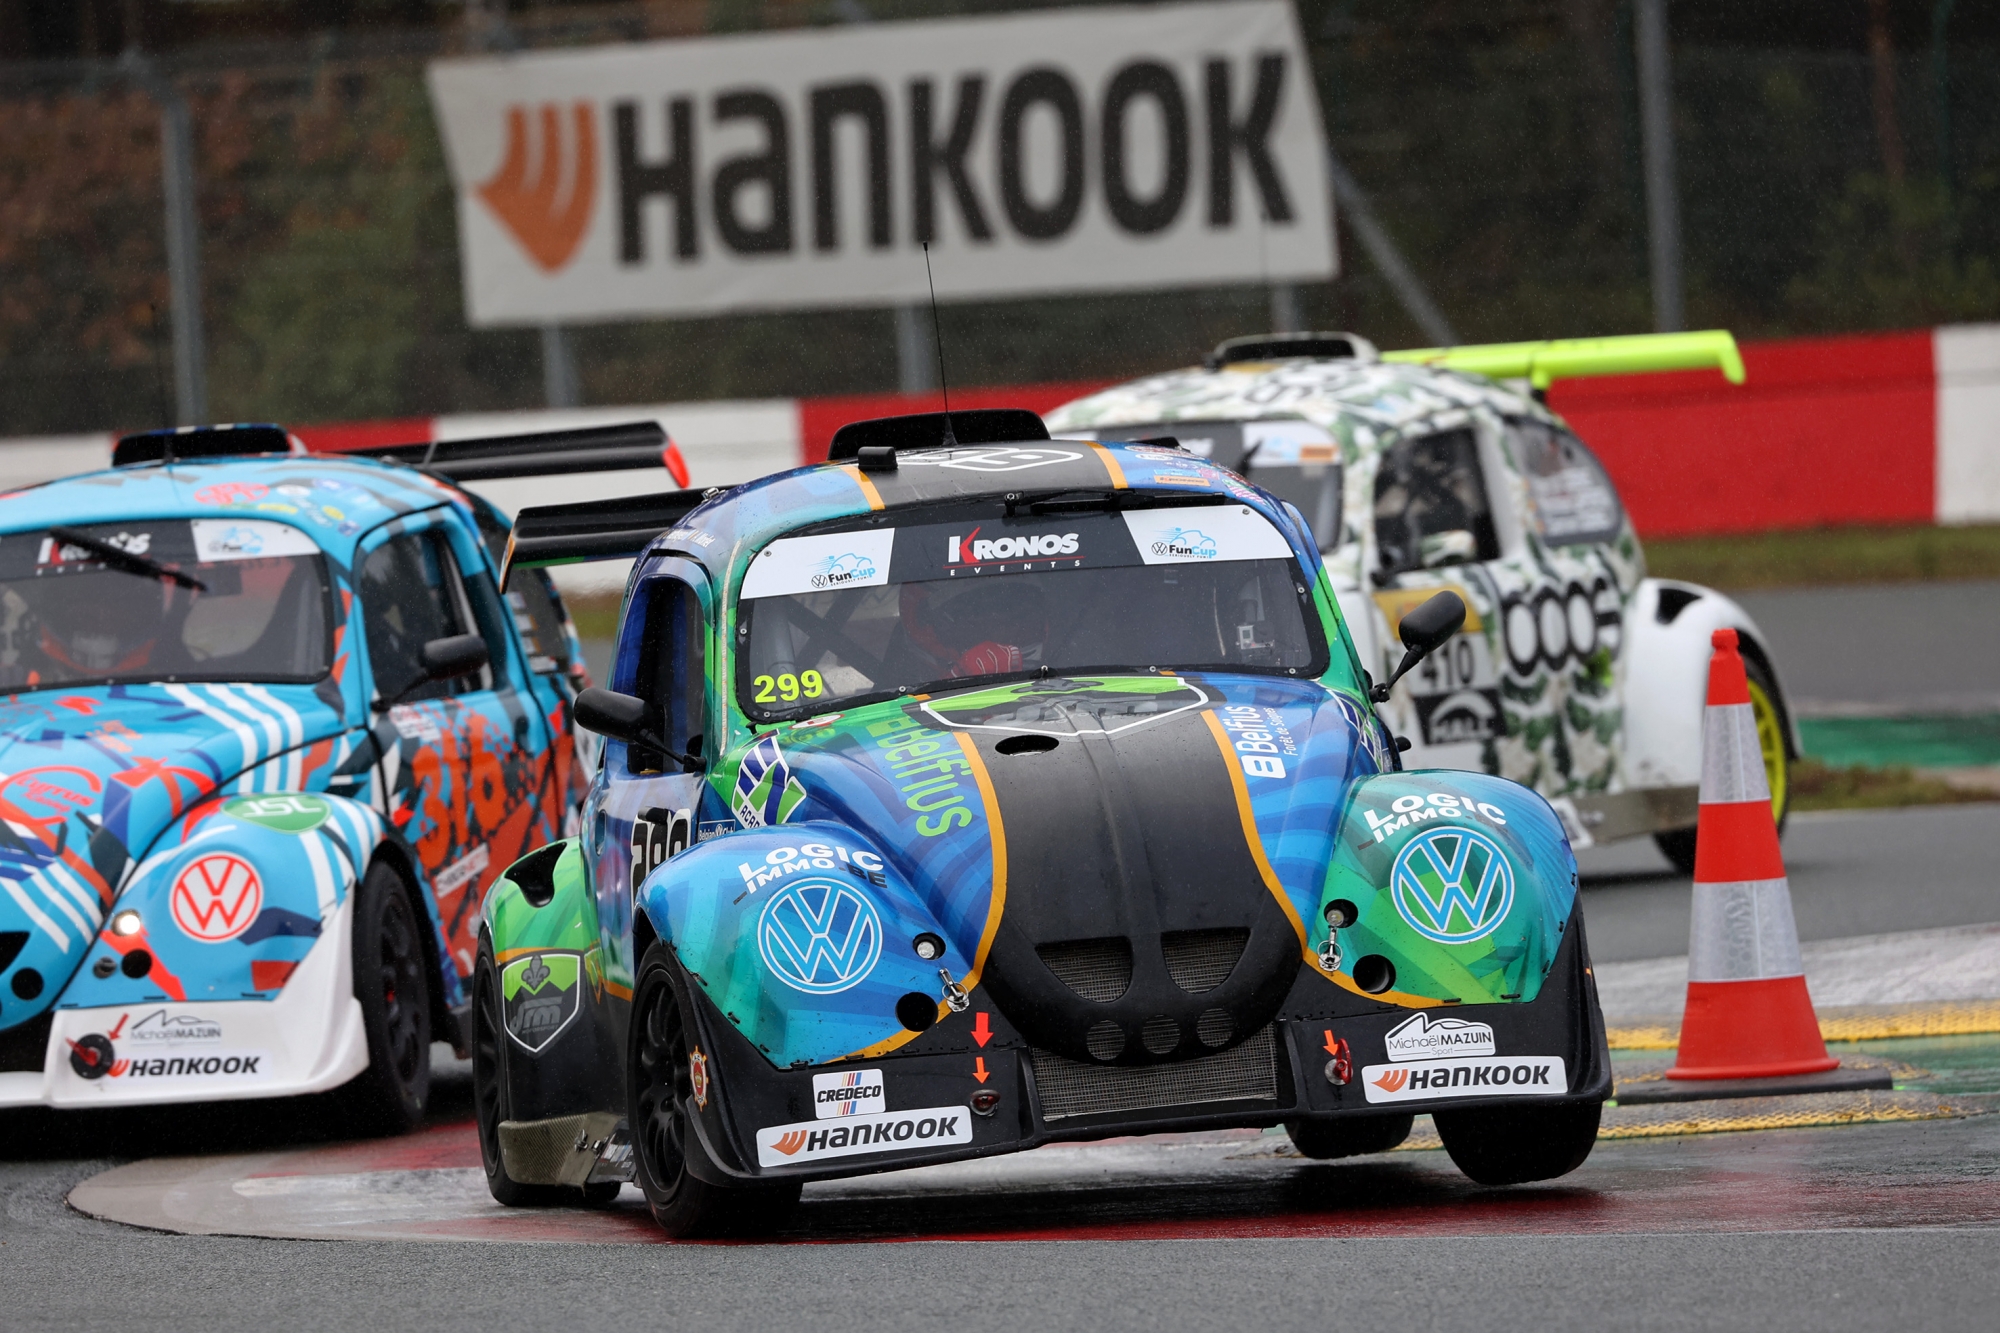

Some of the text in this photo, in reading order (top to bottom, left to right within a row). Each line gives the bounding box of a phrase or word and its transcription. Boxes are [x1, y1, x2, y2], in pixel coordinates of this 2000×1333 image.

[948, 526, 1079, 564] KRONOS
[1169, 544, 1217, 559] FunCup
[828, 567, 876, 583] FunCup
[950, 560, 1081, 576] EVENTS
[753, 669, 823, 704] 299
[1222, 706, 1279, 754] Belfius
[1278, 735, 1299, 756] Forêt
[876, 727, 973, 837] Belfius
[1363, 793, 1507, 831] LOGIC
[738, 843, 884, 882] LOGIC
[1431, 1047, 1454, 1056] Sport
[817, 1085, 881, 1104] CREDECO
